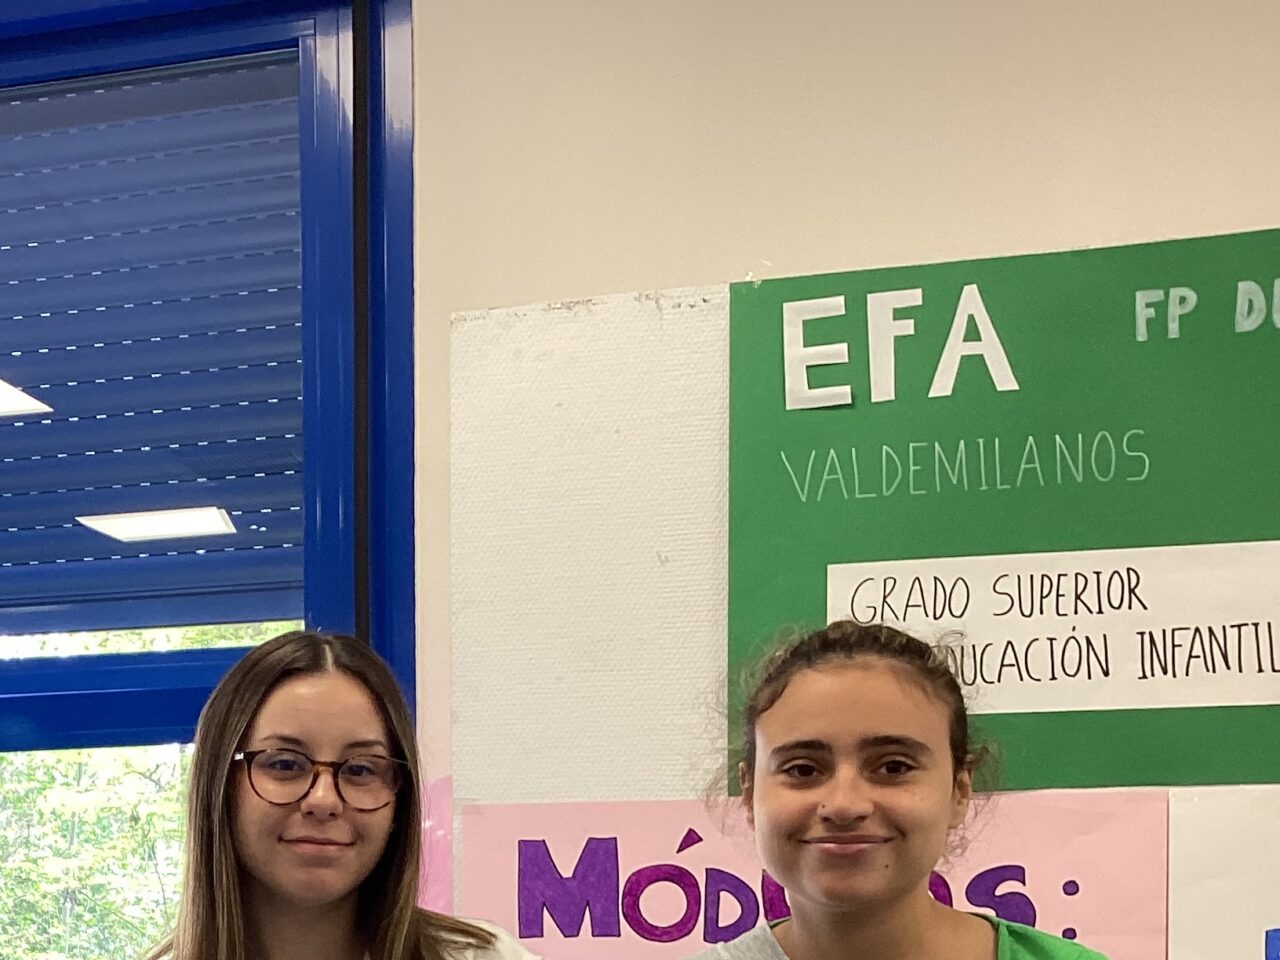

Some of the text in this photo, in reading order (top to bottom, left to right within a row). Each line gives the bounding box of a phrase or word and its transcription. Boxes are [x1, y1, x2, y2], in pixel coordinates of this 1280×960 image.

[1134, 286, 1198, 342] FP
[782, 284, 1020, 411] EFA
[780, 429, 1150, 502] VALDEMILANOS
[850, 567, 1148, 624] GRADO SUPERIOR
